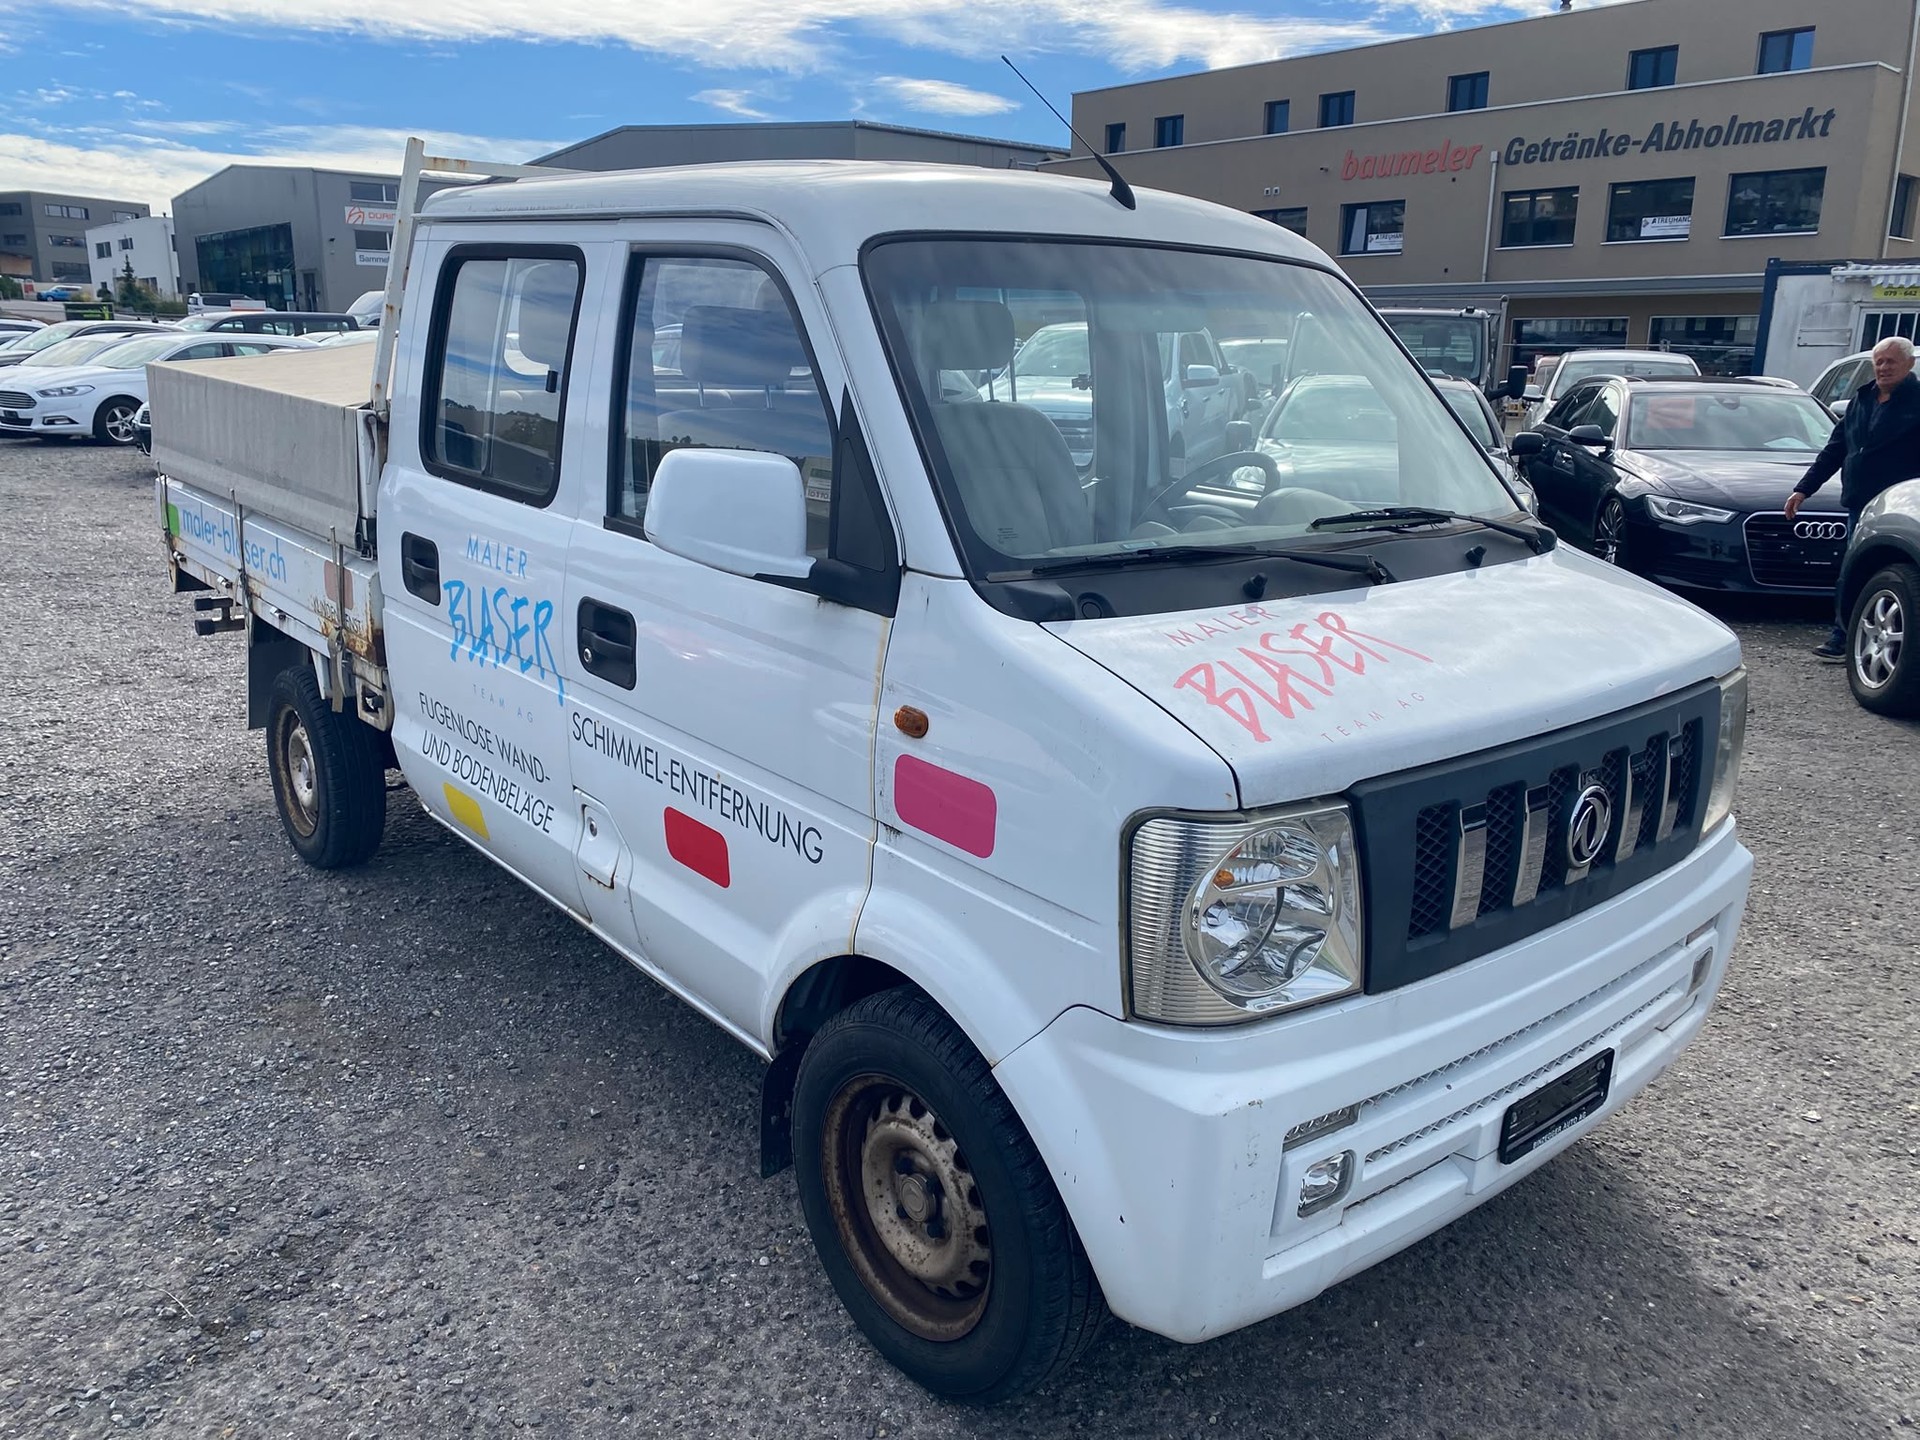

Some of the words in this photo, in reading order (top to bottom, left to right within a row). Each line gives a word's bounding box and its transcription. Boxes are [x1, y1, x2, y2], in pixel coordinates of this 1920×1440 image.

[1342, 138, 1483, 181] baumeler
[1504, 106, 1836, 166] Getränke-Abholmarkt
[466, 534, 528, 579] MALER
[443, 580, 564, 707] BLASER
[1164, 606, 1281, 647] MALER
[473, 684, 505, 707] TEAM
[517, 706, 534, 723] AG
[1173, 611, 1434, 743] BLASER
[419, 691, 494, 755] FUGENLOSE
[495, 734, 551, 783] WAND-
[1321, 710, 1385, 743] TEAM
[1397, 691, 1426, 710] AG
[422, 730, 451, 766] UND
[451, 748, 555, 834] BODENBELÄGE
[572, 711, 824, 864] SCHIMMEL-ENTFERNUNG
